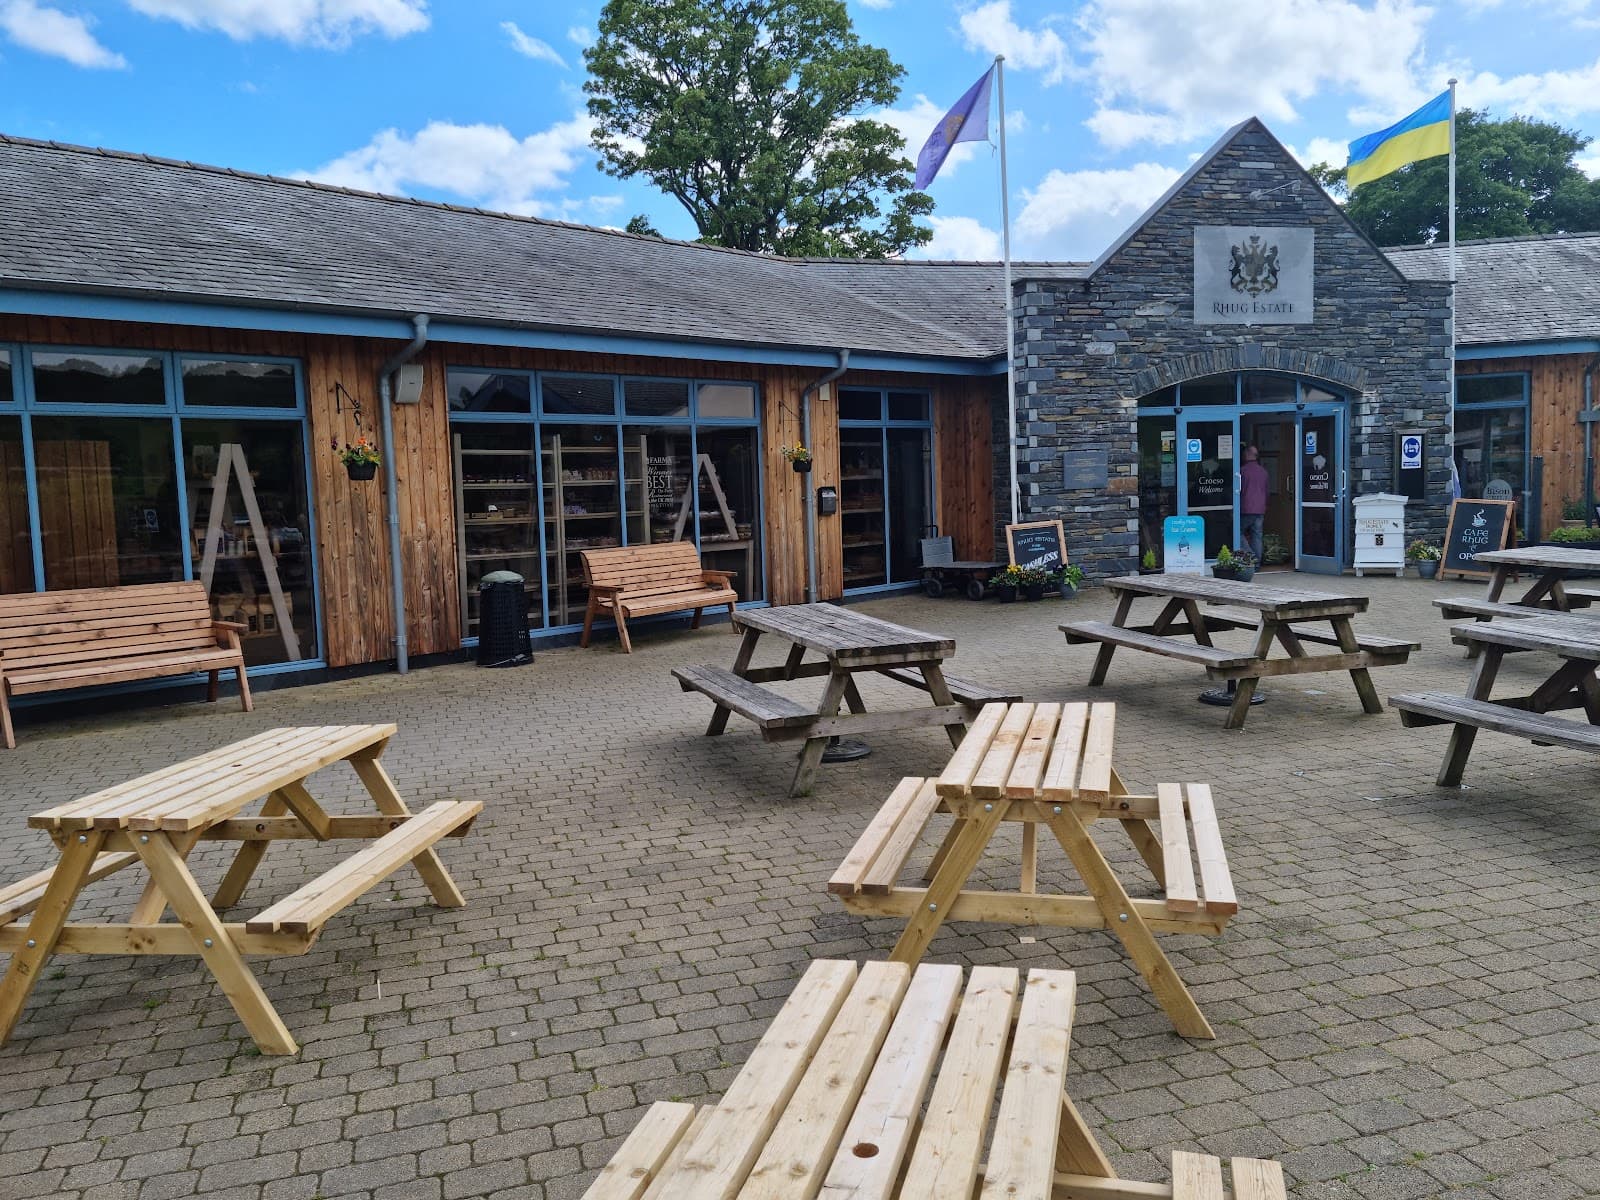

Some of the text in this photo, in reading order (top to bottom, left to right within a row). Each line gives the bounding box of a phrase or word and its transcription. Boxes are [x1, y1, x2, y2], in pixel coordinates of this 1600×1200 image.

[1213, 302, 1294, 317] RHUG ESTATE
[647, 475, 672, 489] BEST
[1199, 476, 1224, 485] Croeso
[1199, 485, 1224, 494] Welcome
[1464, 528, 1489, 537] CAFE
